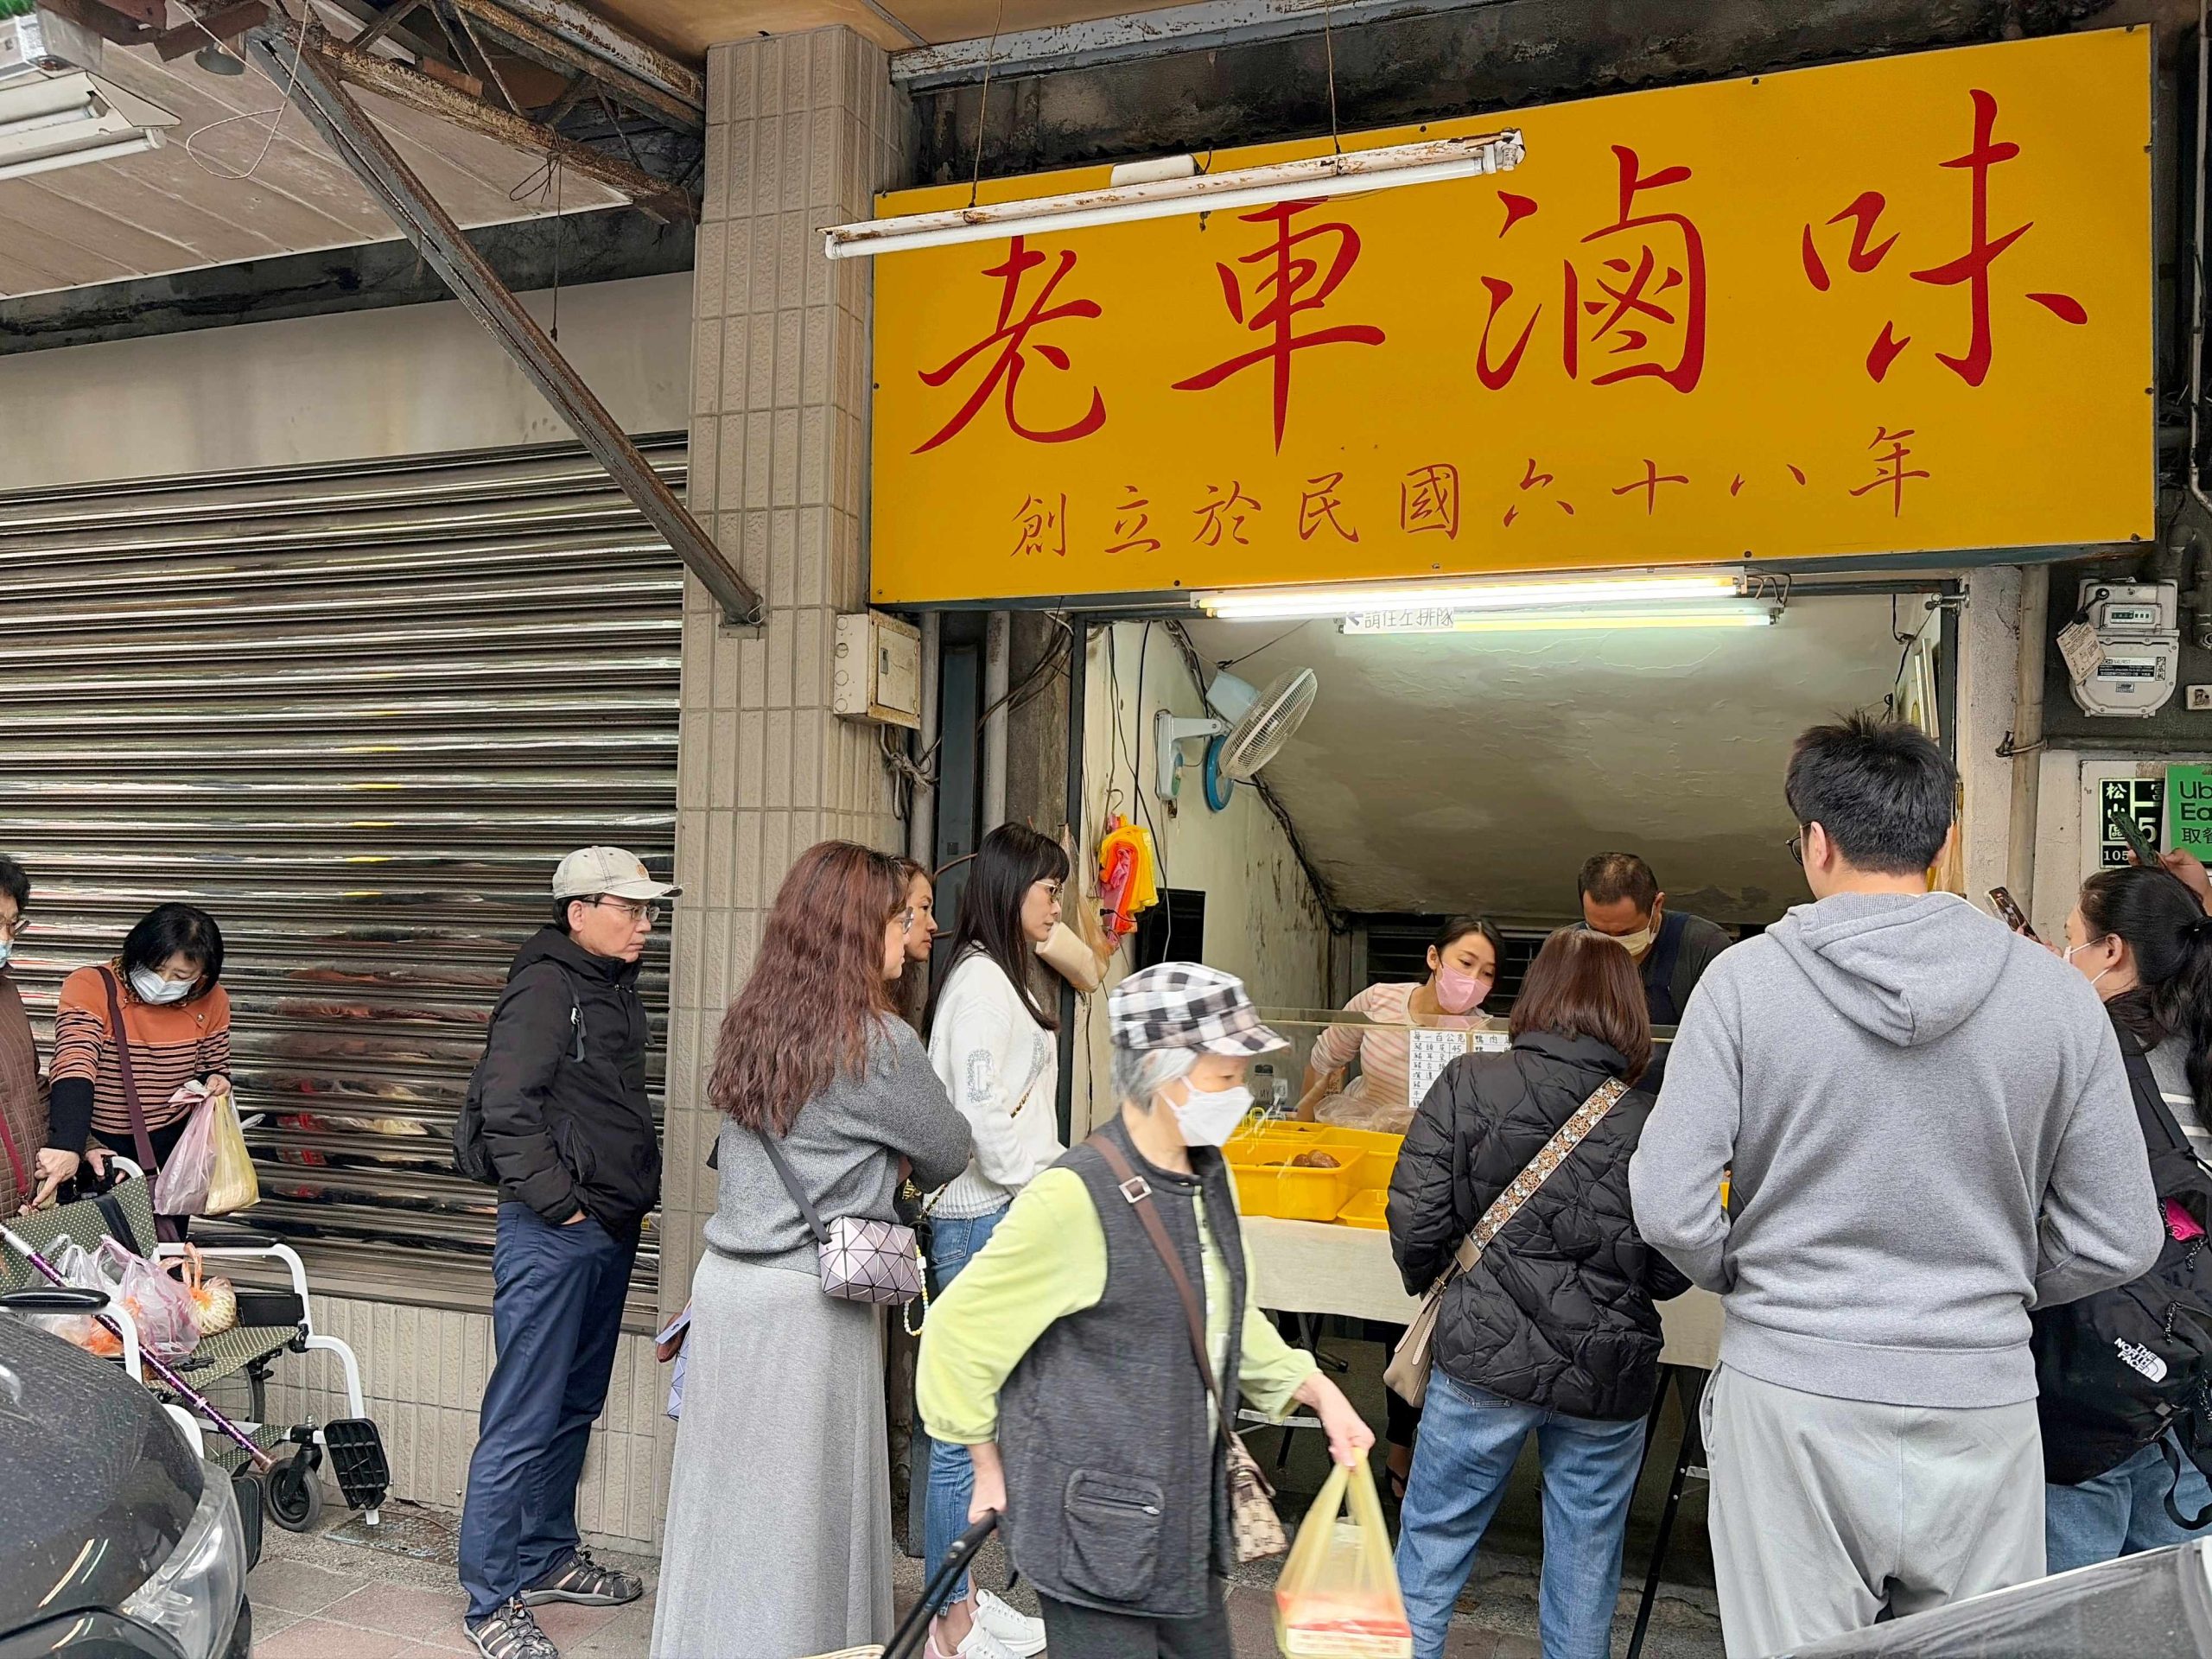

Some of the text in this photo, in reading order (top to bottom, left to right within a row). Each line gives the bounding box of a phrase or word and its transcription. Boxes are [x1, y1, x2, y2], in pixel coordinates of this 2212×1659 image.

[910, 88, 2088, 457] 老車滷味
[1011, 426, 1930, 558] 創立於民國六十八年
[2113, 1337, 2152, 1367] NORTH
[2117, 1350, 2145, 1372] FACE
[2136, 1342, 2158, 1362] THE
